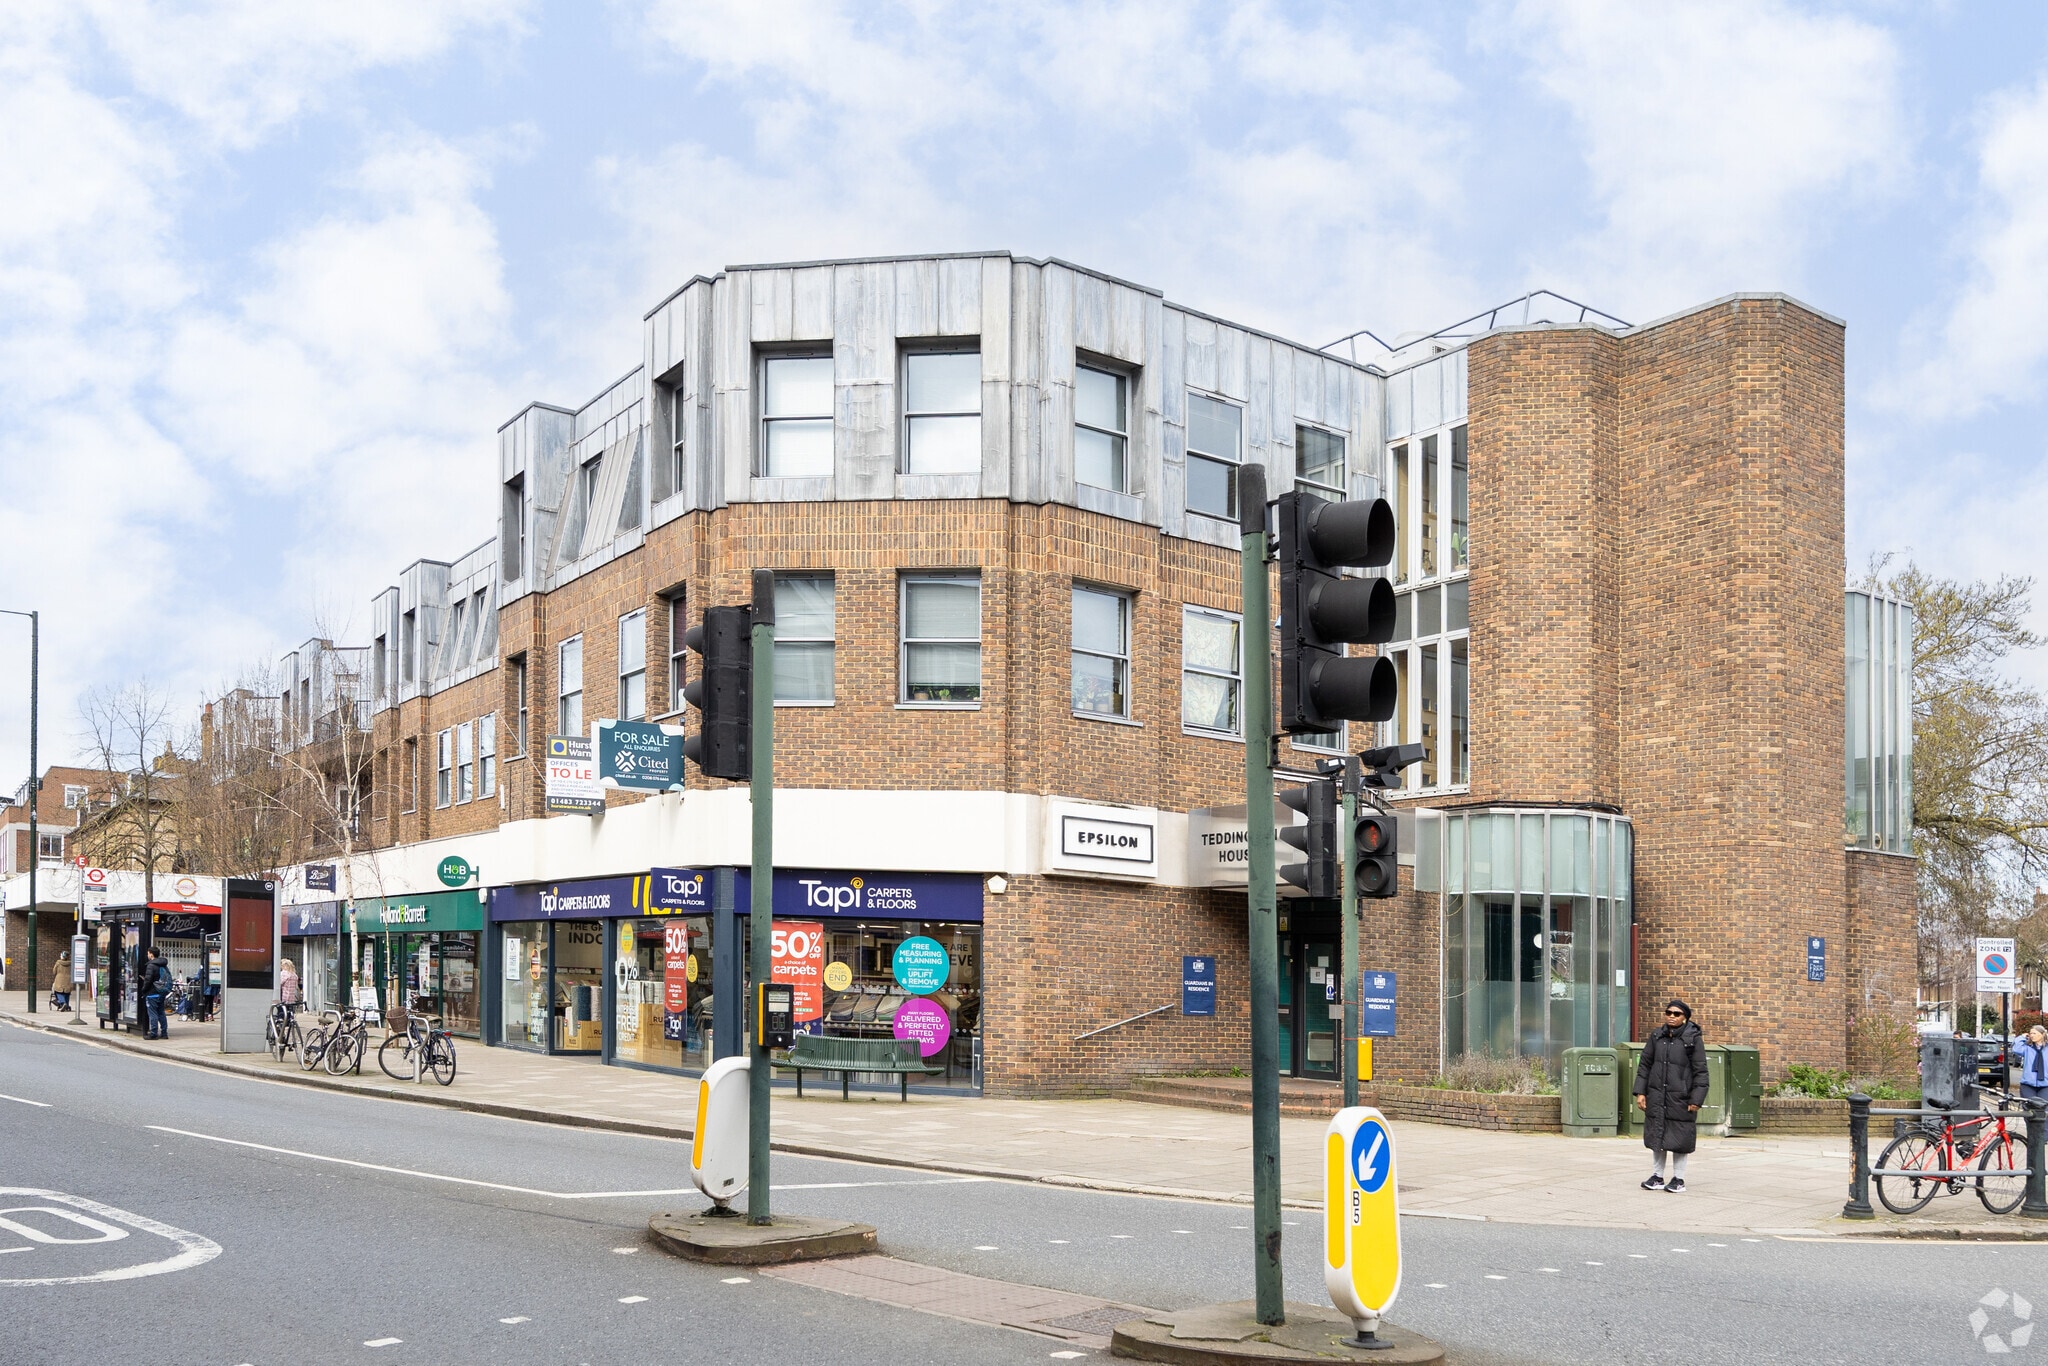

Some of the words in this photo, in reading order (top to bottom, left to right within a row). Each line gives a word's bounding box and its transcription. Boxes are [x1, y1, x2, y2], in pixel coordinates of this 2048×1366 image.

[614, 731, 639, 744] FOR
[641, 733, 670, 747] SALE
[568, 749, 591, 757] Warn
[638, 755, 669, 770] Cited
[550, 767, 571, 779] TO
[575, 769, 592, 780] LE
[574, 799, 601, 807] 723344
[1078, 831, 1138, 848] EPSILON
[78, 857, 86, 866] E
[1218, 850, 1249, 863] HOUS
[662, 874, 703, 898] Tapi
[798, 876, 864, 913] Tapi
[867, 888, 912, 898] CARPETS
[539, 886, 559, 916] Tapi
[558, 895, 582, 911] CARPETS
[587, 894, 611, 909] FLOORS
[661, 897, 682, 905] CARPETS
[867, 899, 875, 909] &
[877, 898, 917, 910] FLOORS
[163, 914, 201, 933] Boots
[569, 923, 588, 931] THE
[665, 928, 686, 954] 50%
[771, 930, 821, 958] 50%
[905, 957, 943, 965] PLANNING
[773, 964, 817, 976] carpets
[828, 974, 847, 982] END
[908, 978, 939, 986] REMOVE
[901, 1015, 941, 1023] DELIVERED
[904, 1022, 945, 1030] PERFECTLY
[908, 1029, 934, 1037] FITTED
